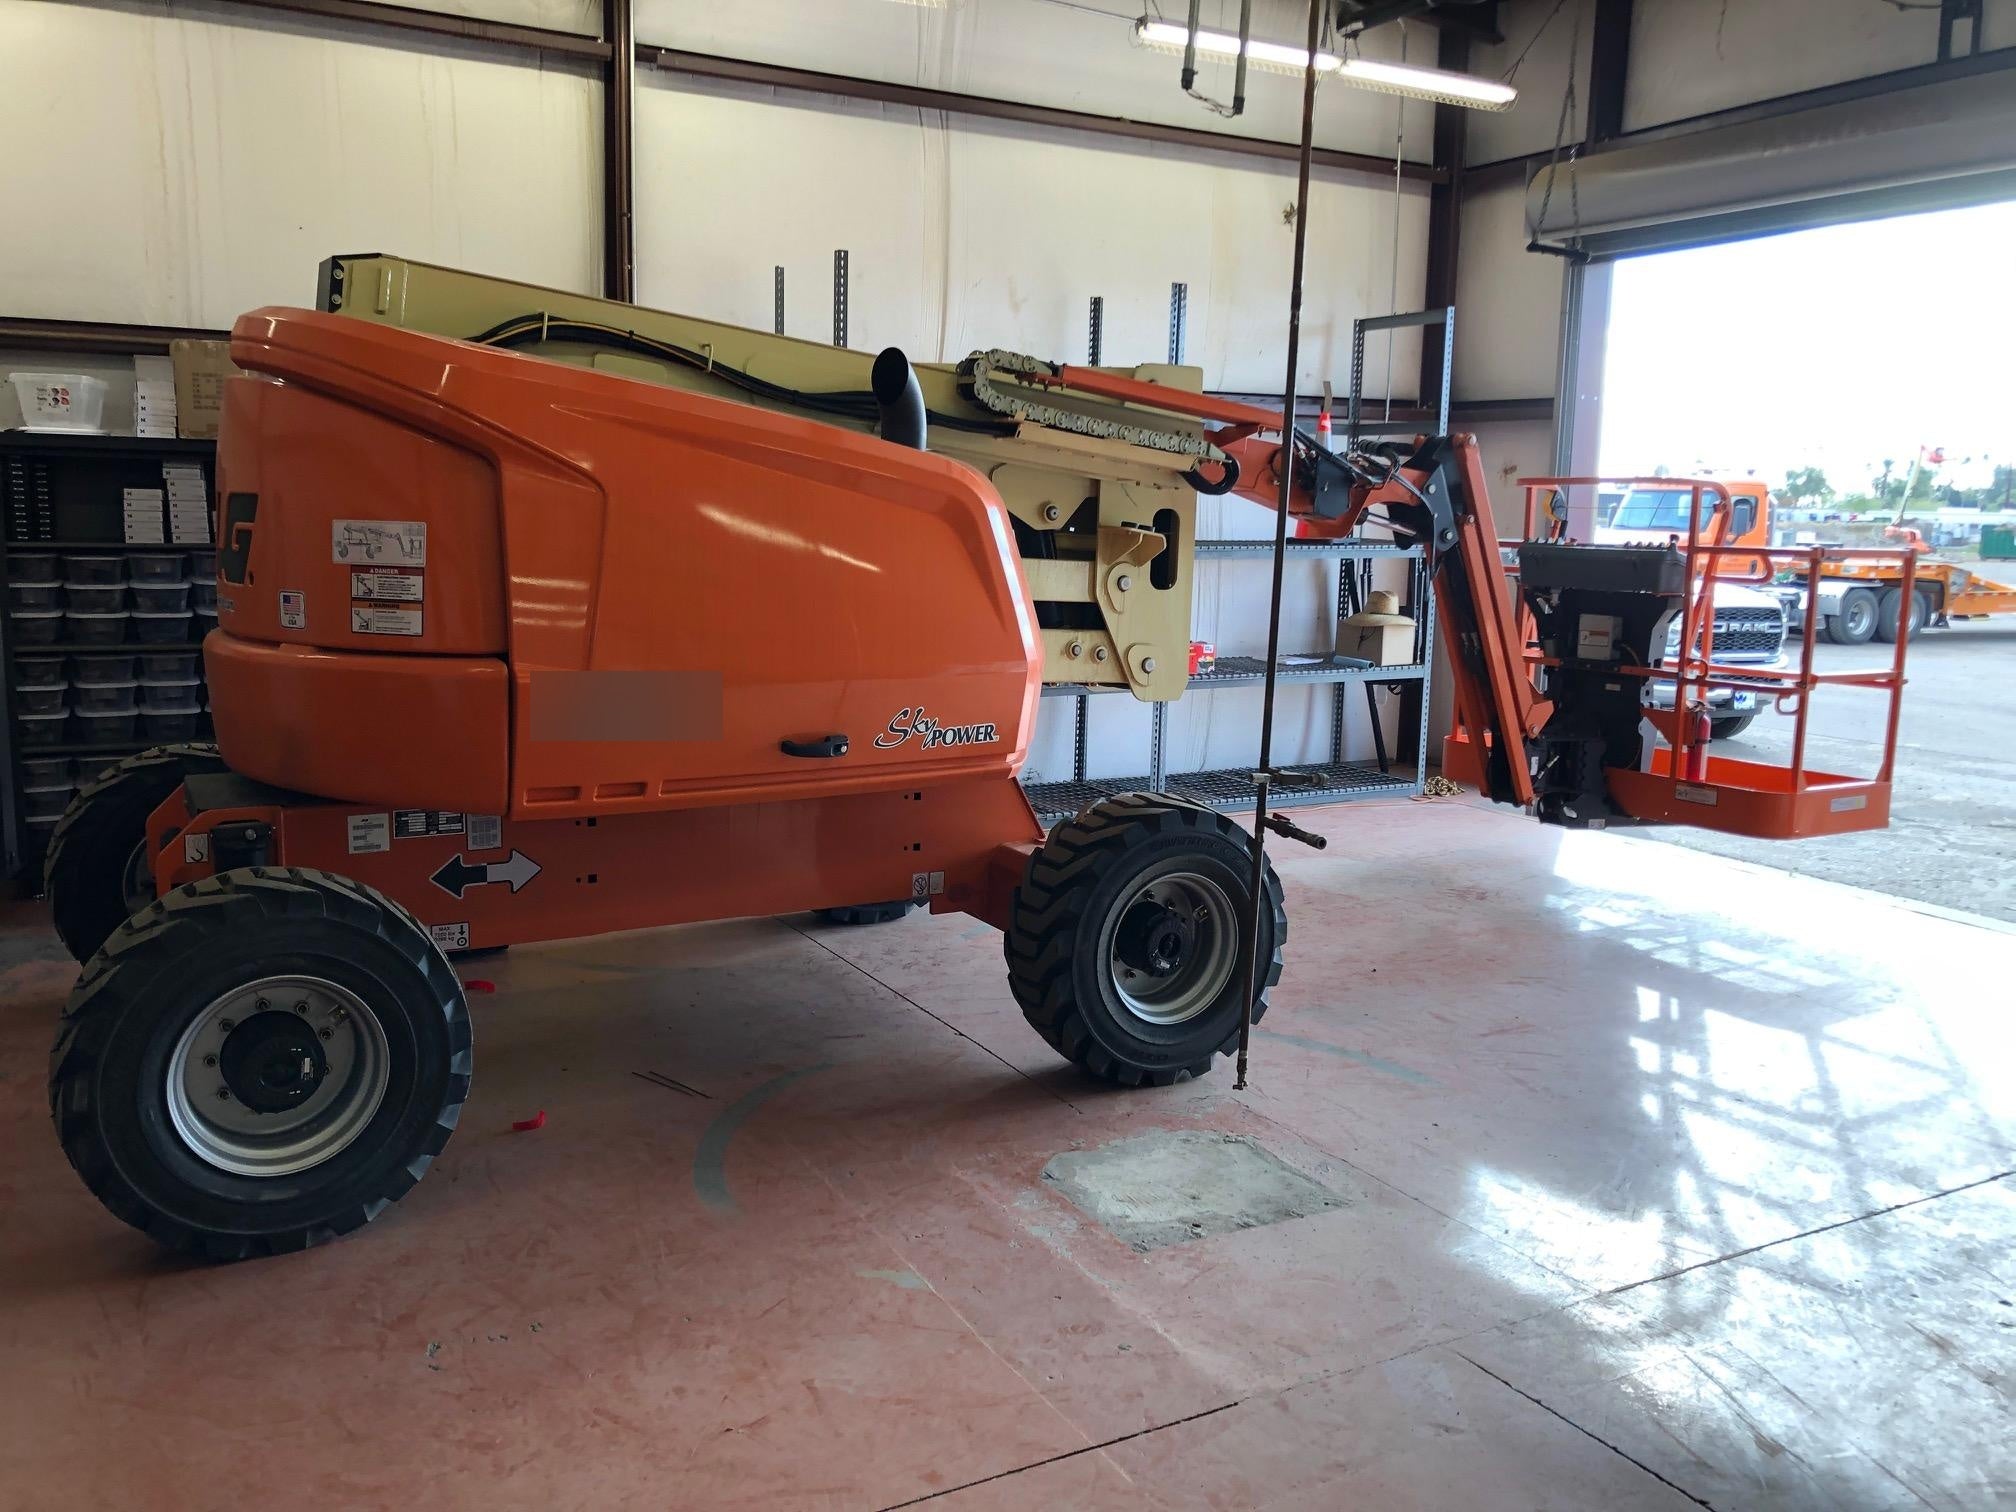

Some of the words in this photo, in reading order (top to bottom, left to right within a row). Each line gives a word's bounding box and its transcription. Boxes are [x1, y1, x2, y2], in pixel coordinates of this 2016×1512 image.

[1728, 623, 1766, 632] RAM
[874, 707, 938, 750] Sky
[930, 723, 996, 748] POWER
